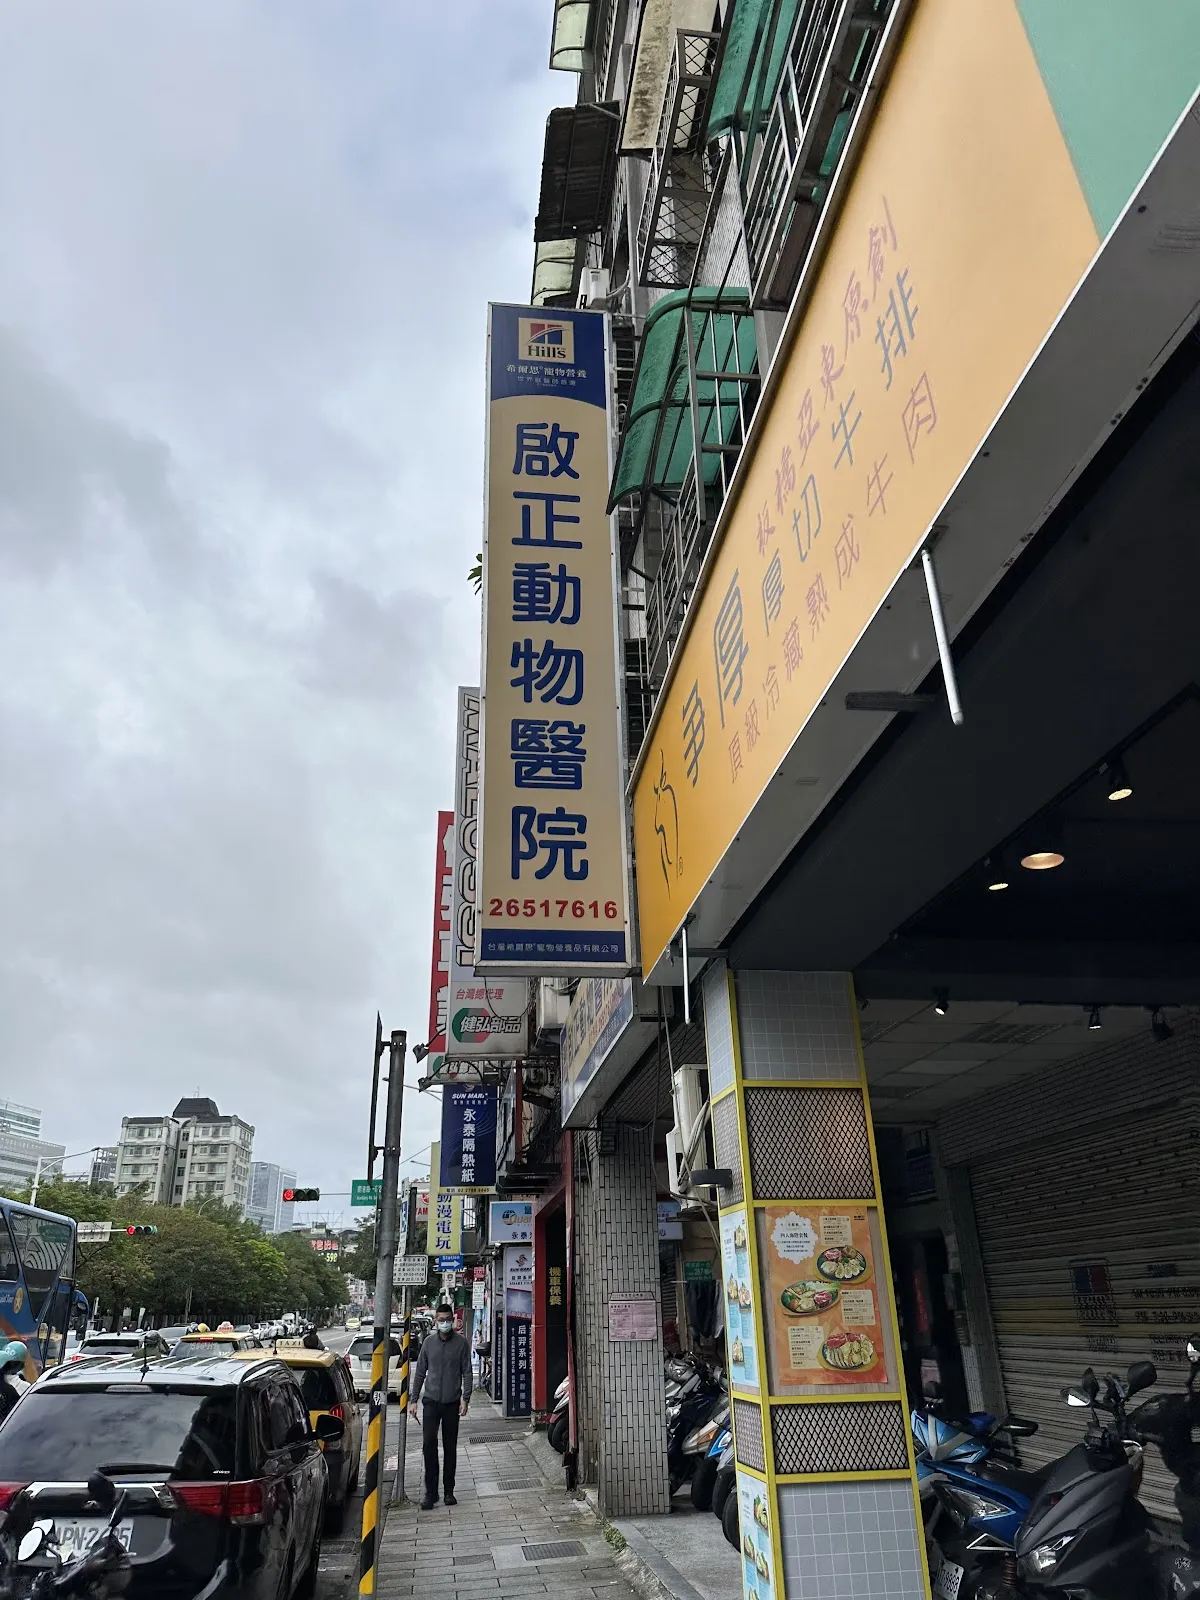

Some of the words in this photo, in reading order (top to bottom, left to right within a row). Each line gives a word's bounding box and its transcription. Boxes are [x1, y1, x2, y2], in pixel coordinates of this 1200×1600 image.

[527, 345, 567, 359] Hill's
[756, 195, 898, 557] 板橋亞東原創
[760, 266, 919, 638] 厚切牛排
[729, 370, 938, 784] 頂級冷藏熟成牛肉
[511, 422, 589, 881] 啟正動物醫院
[489, 898, 618, 919] 26517616
[455, 988, 504, 1000] 台灣總代理
[460, 1015, 522, 1034] 健弘部品
[461, 1108, 476, 1183] 永泰隔熱紙
[549, 1266, 562, 1305] 機車保養
[517, 1324, 527, 1370] 后羿系列
